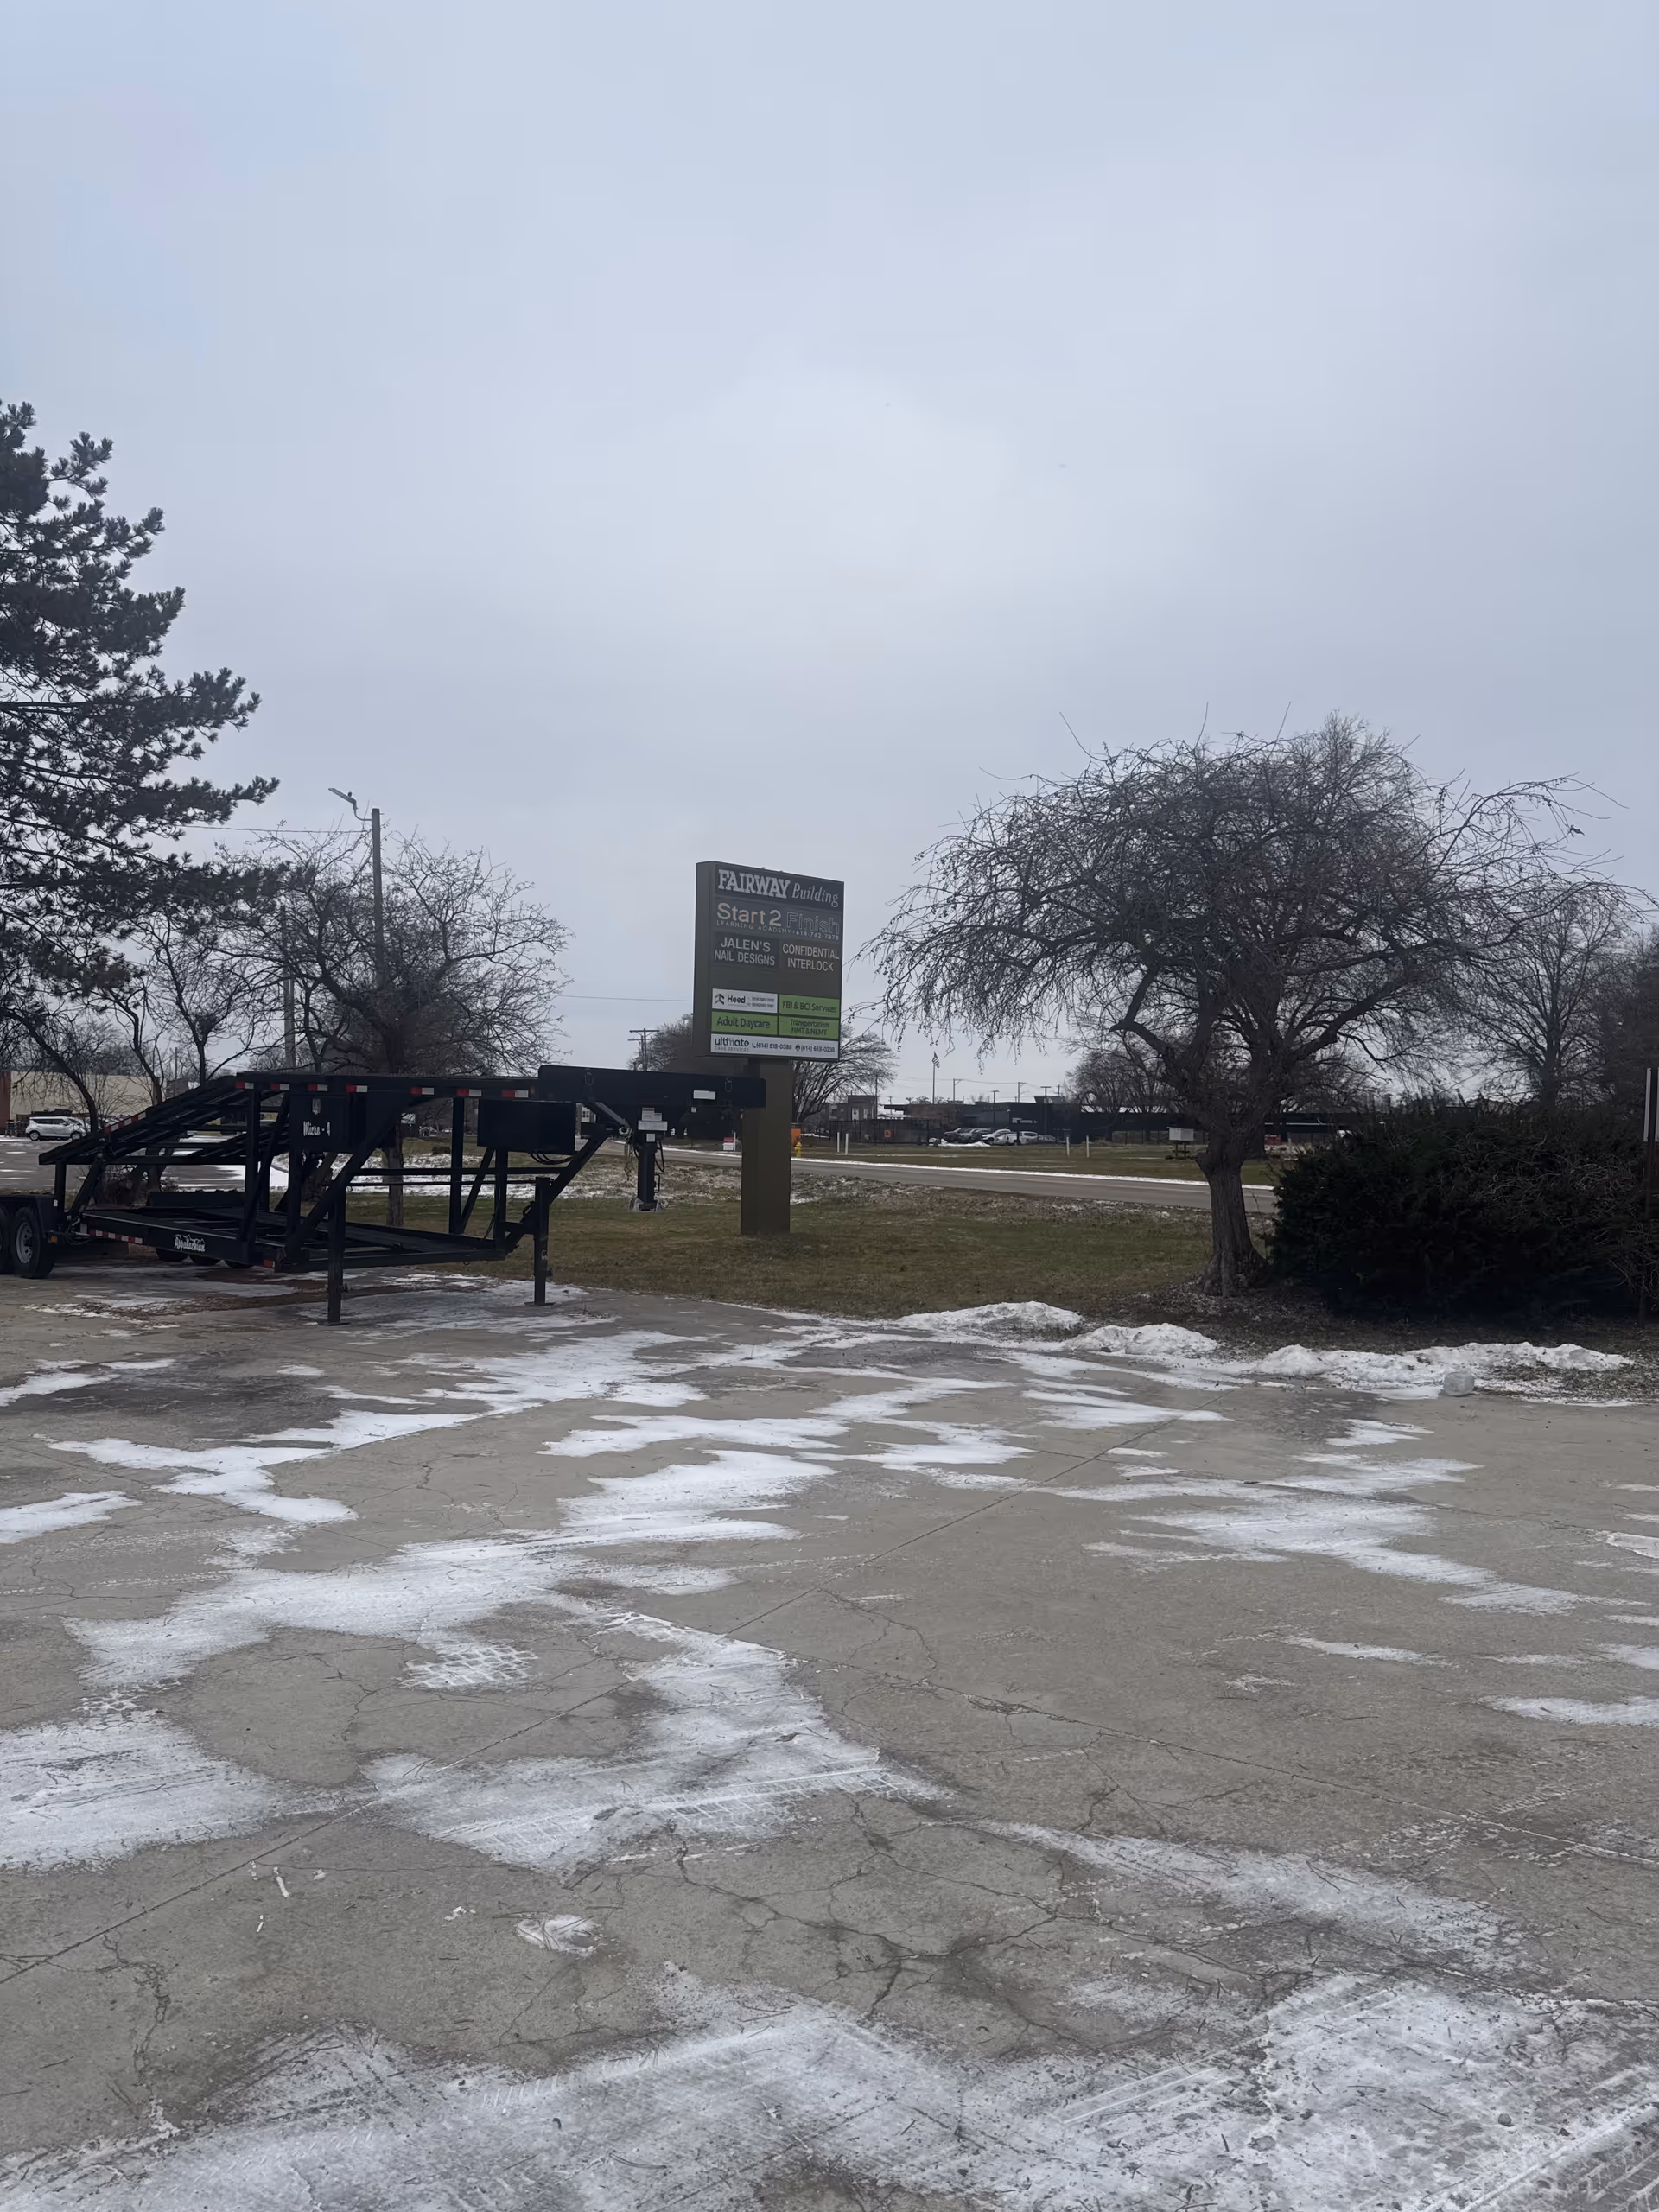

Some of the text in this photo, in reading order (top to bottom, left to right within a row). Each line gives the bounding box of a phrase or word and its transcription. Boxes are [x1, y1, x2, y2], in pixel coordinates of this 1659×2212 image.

[717, 869, 839, 908] FAIRWAY Building
[716, 919, 753, 930] LEARNING
[757, 925, 791, 934] ACADEMY
[717, 903, 840, 935] Start 2 Finish
[720, 937, 771, 952] JALEN'S
[782, 944, 840, 960] CONFIDENTIAL
[714, 950, 775, 967] NAIL DESIGNS
[787, 957, 835, 972] INTERLOCK
[727, 995, 746, 1004] Heed
[782, 1001, 793, 1010] FBI
[793, 1001, 798, 1010] &
[811, 1002, 837, 1013] Services
[716, 1016, 771, 1030] Adult Daycare
[790, 1019, 830, 1029] Transportation
[714, 1036, 750, 1047] ultimate
[303, 1121, 321, 1137] Micro
